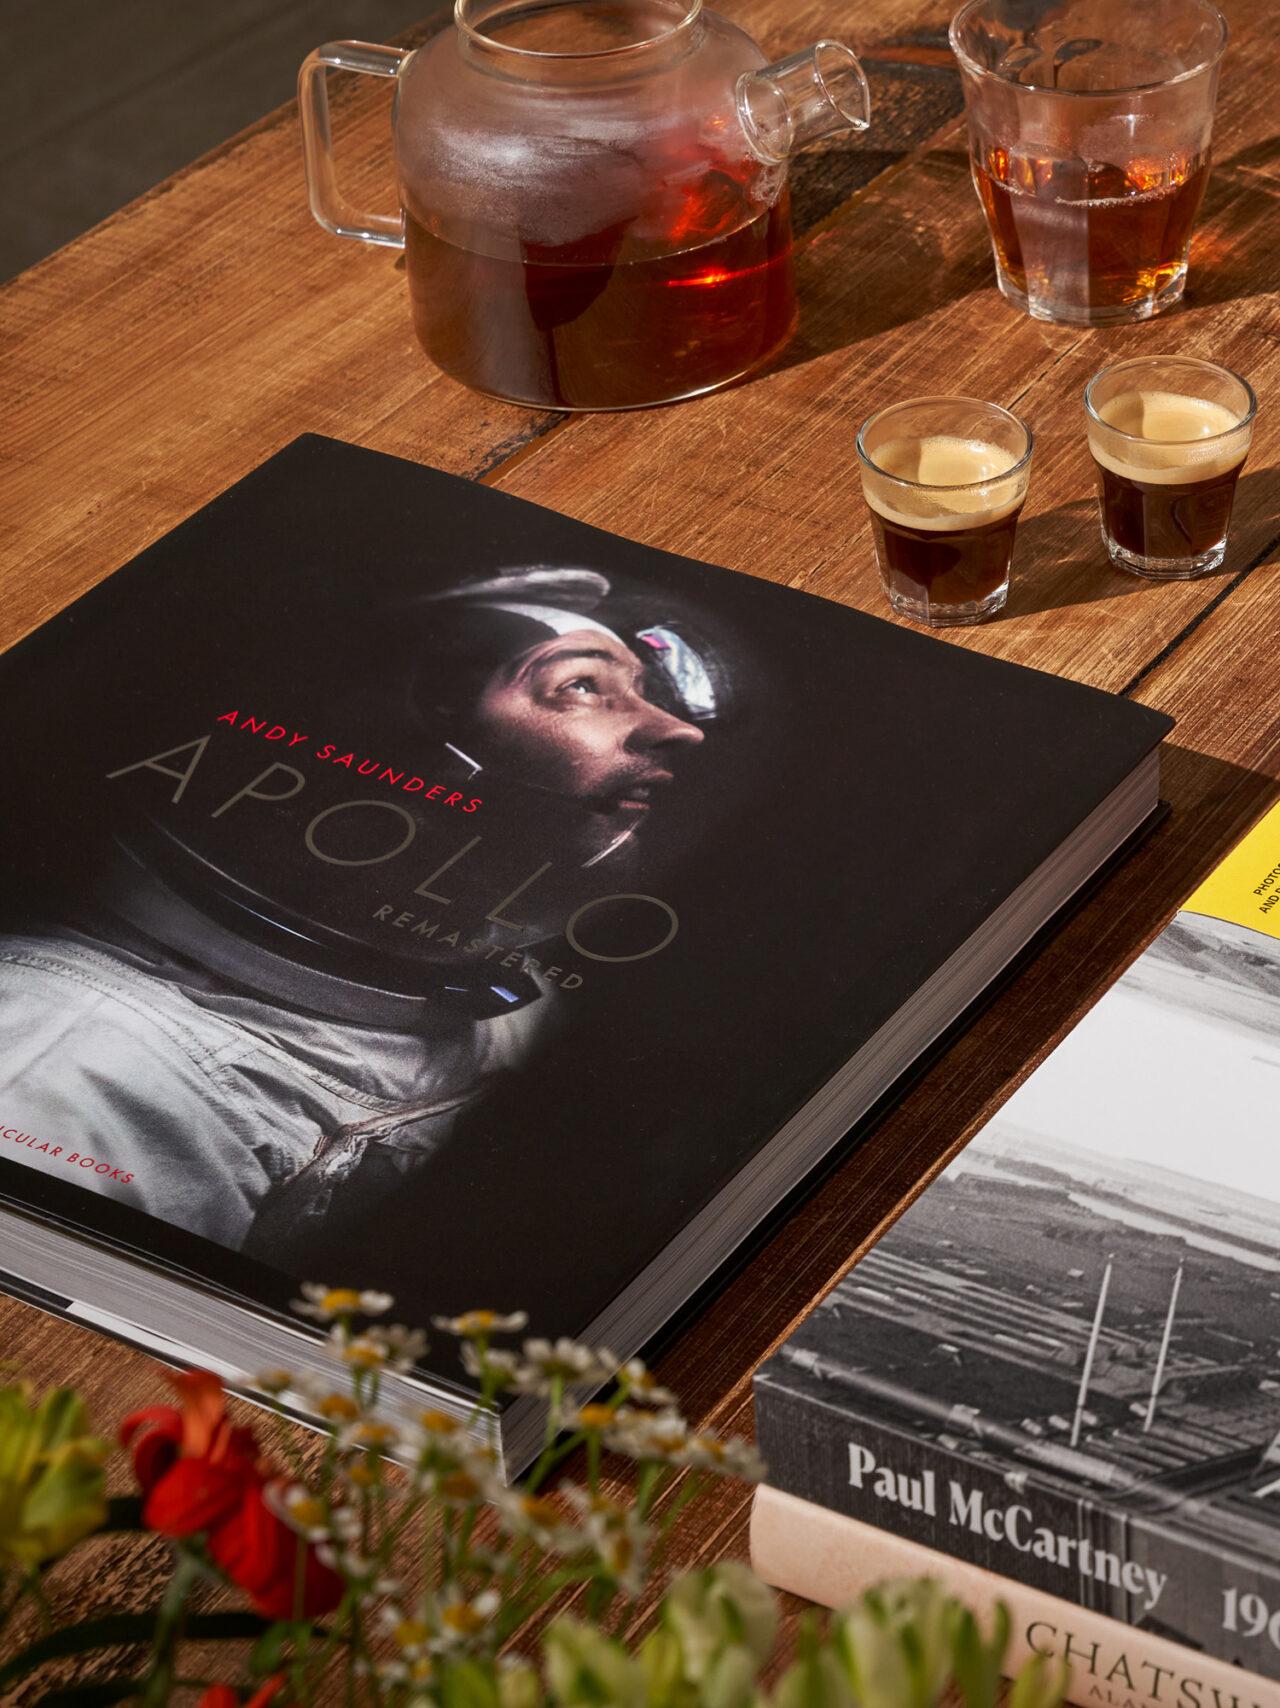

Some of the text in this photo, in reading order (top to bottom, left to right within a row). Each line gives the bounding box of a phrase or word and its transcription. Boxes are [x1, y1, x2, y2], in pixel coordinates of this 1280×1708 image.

[217, 709, 483, 815] ANDY SAUNDERS
[106, 734, 679, 963] APOLLO
[372, 903, 584, 990] REMASTERED
[1259, 894, 1280, 915] AND
[66, 1152, 134, 1184] BOOKS
[848, 1442, 937, 1517] Paul
[948, 1480, 1167, 1610] McCartney
